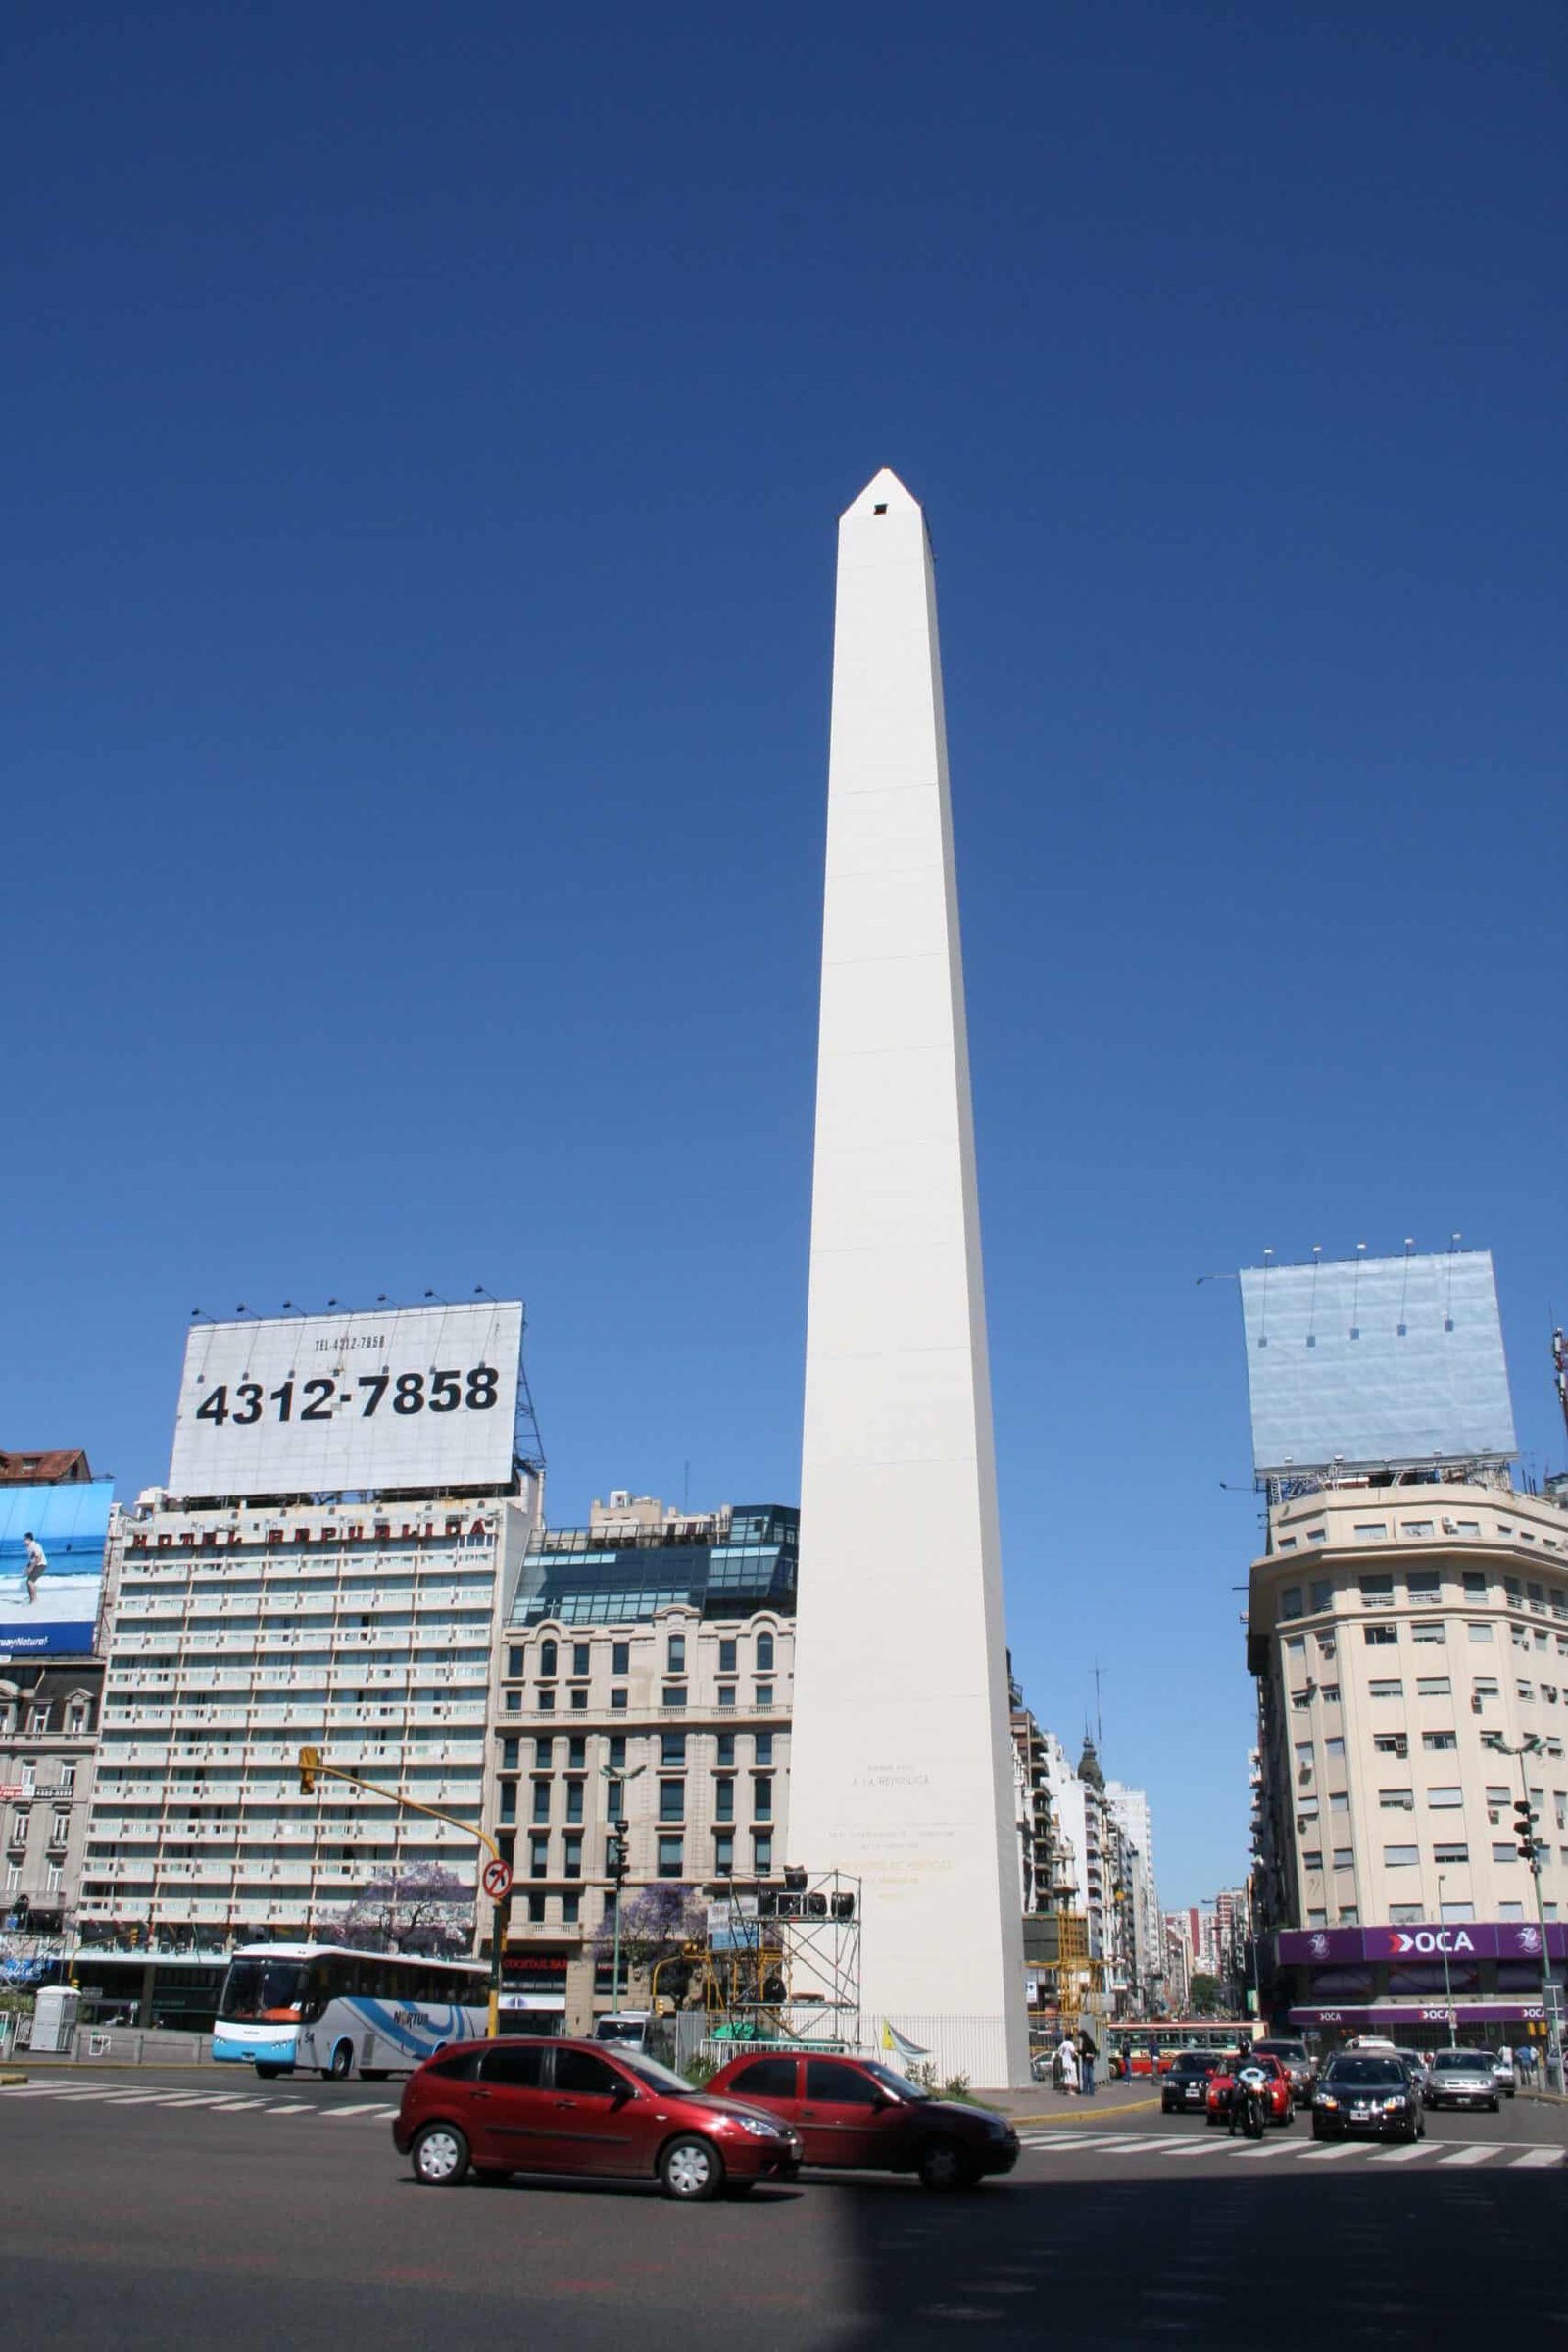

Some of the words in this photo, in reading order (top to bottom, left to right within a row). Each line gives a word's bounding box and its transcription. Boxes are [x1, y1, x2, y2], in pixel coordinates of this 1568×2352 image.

[196, 1368, 499, 1426] 4312-7858
[131, 1530, 243, 1547] HOTEL
[268, 1518, 488, 1544] REPUBLICA
[1415, 1931, 1475, 1952] OCA
[1324, 2012, 1342, 2022] OCA
